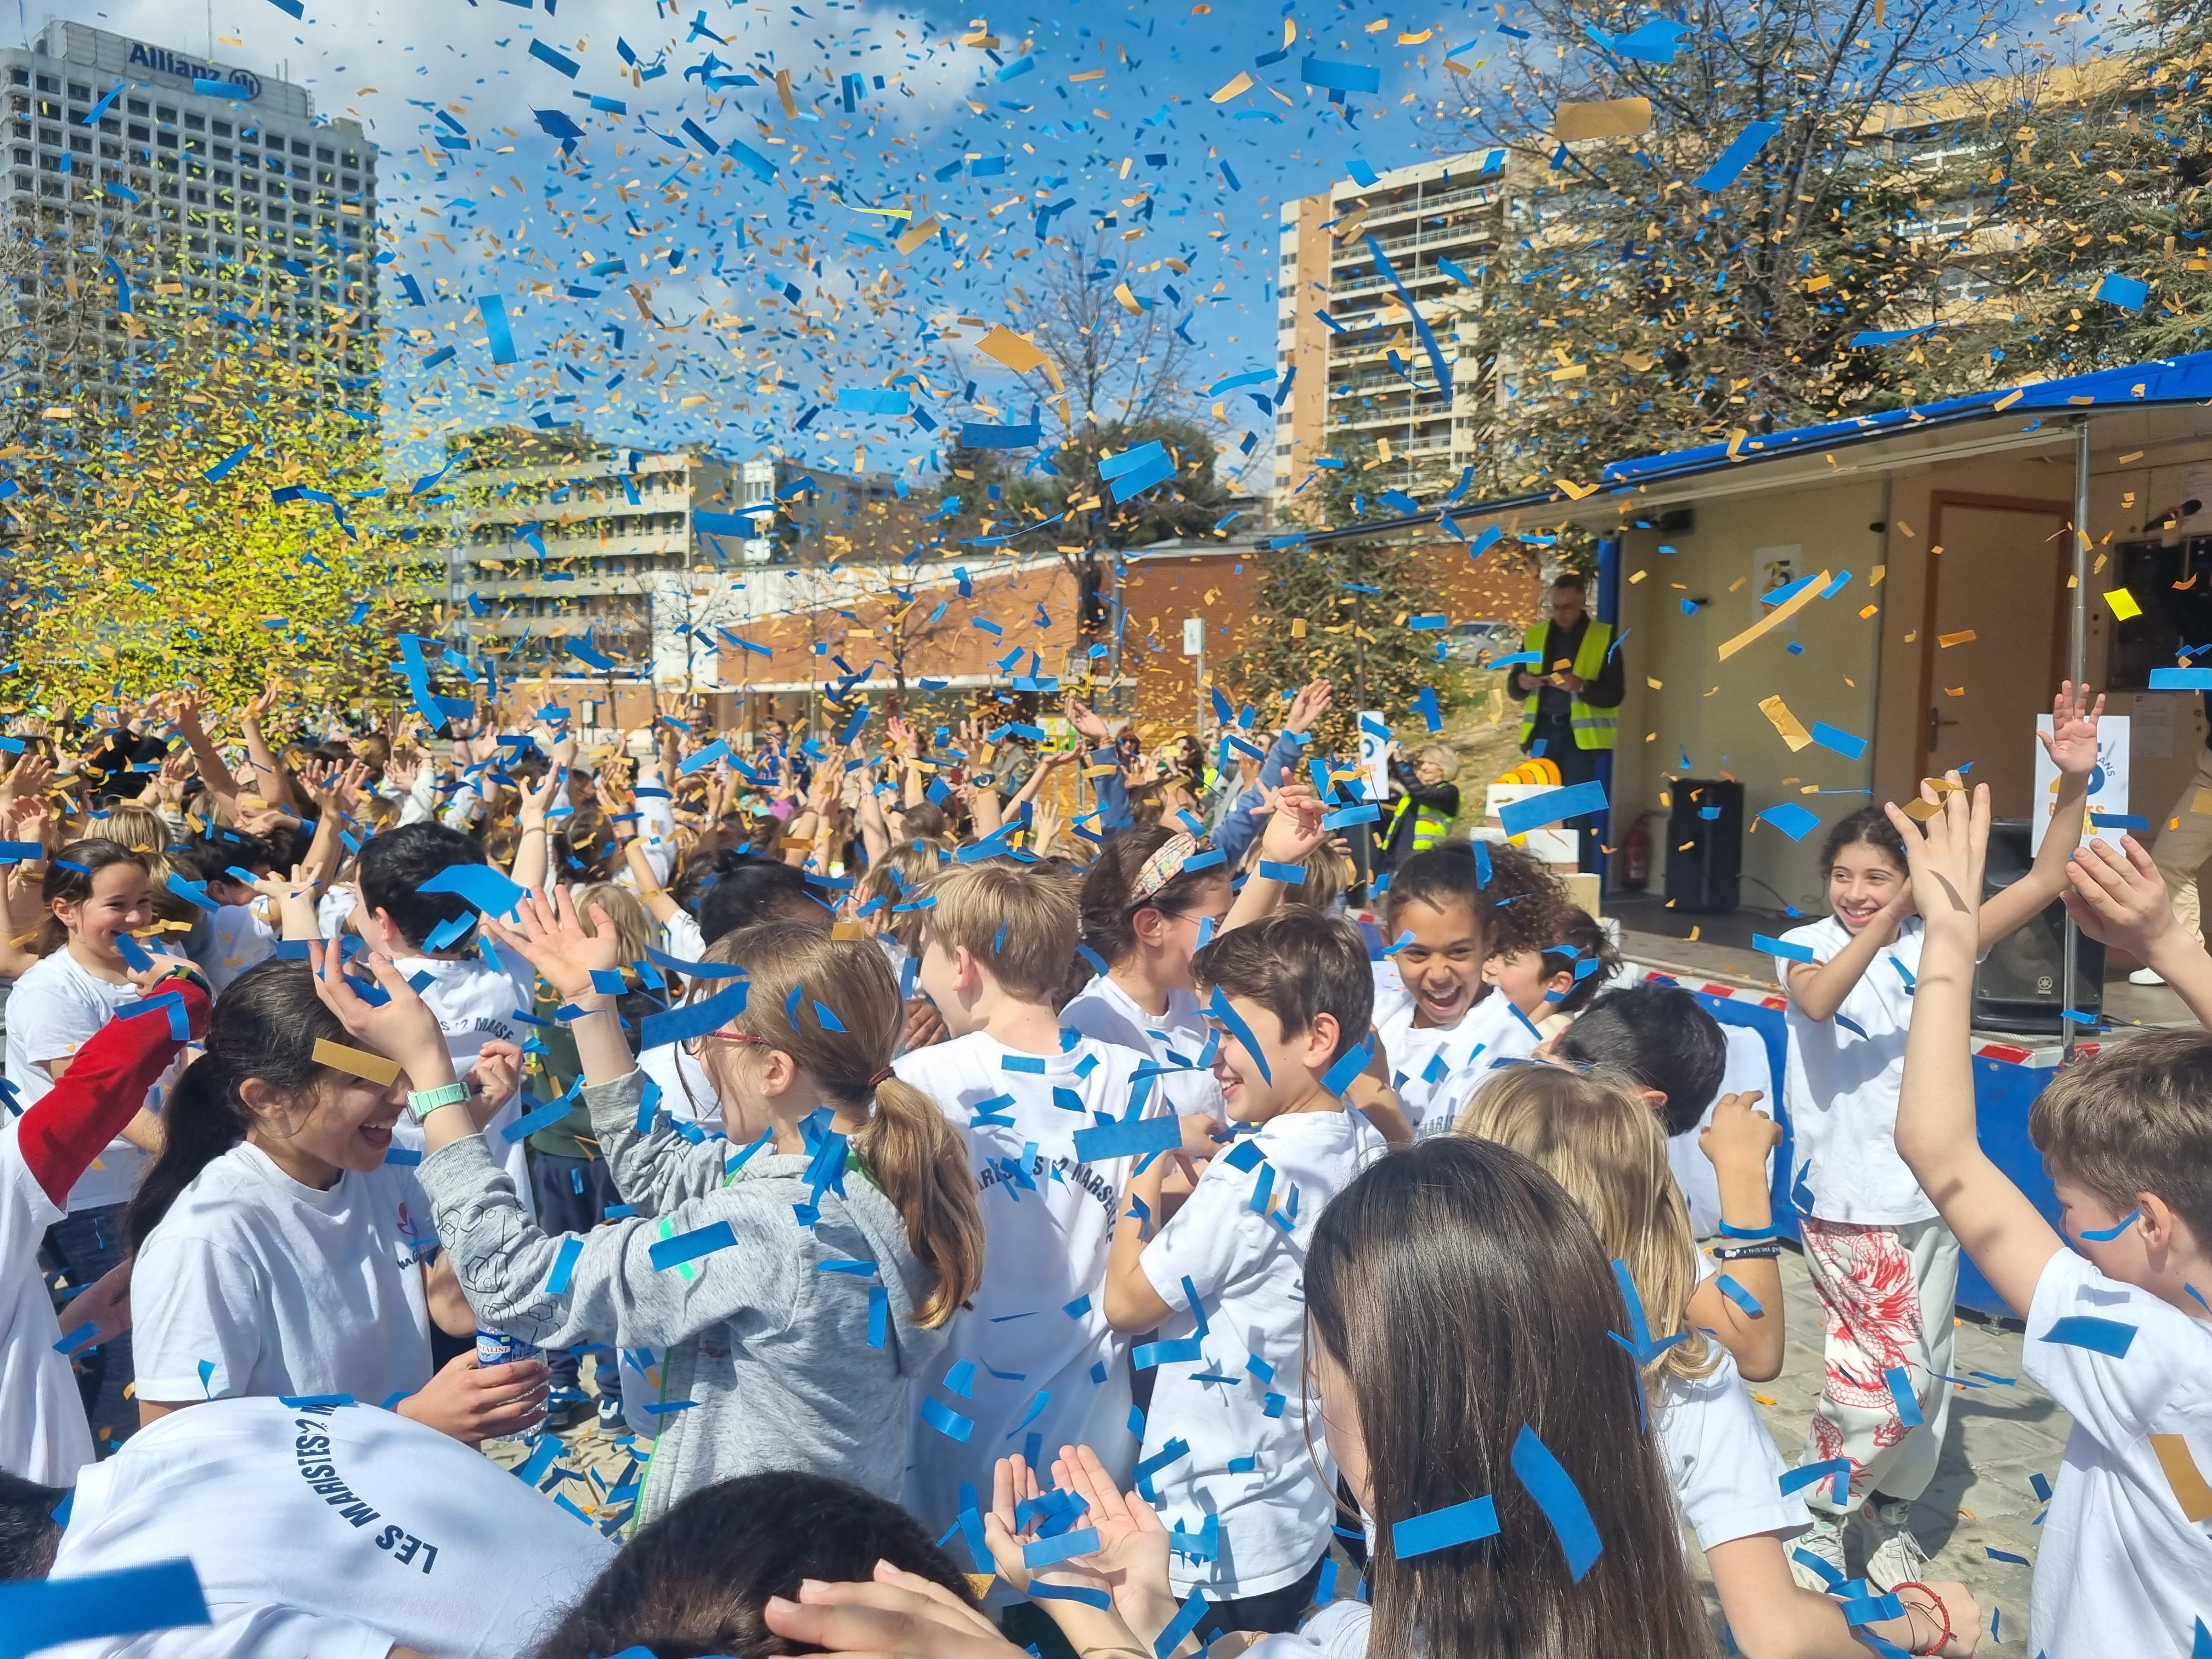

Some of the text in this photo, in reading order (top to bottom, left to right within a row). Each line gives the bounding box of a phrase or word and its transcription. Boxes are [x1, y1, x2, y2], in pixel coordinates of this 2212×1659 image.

[129, 42, 222, 81] Allianz
[295, 1433, 381, 1528] MARISTES
[375, 1525, 438, 1575] LES
